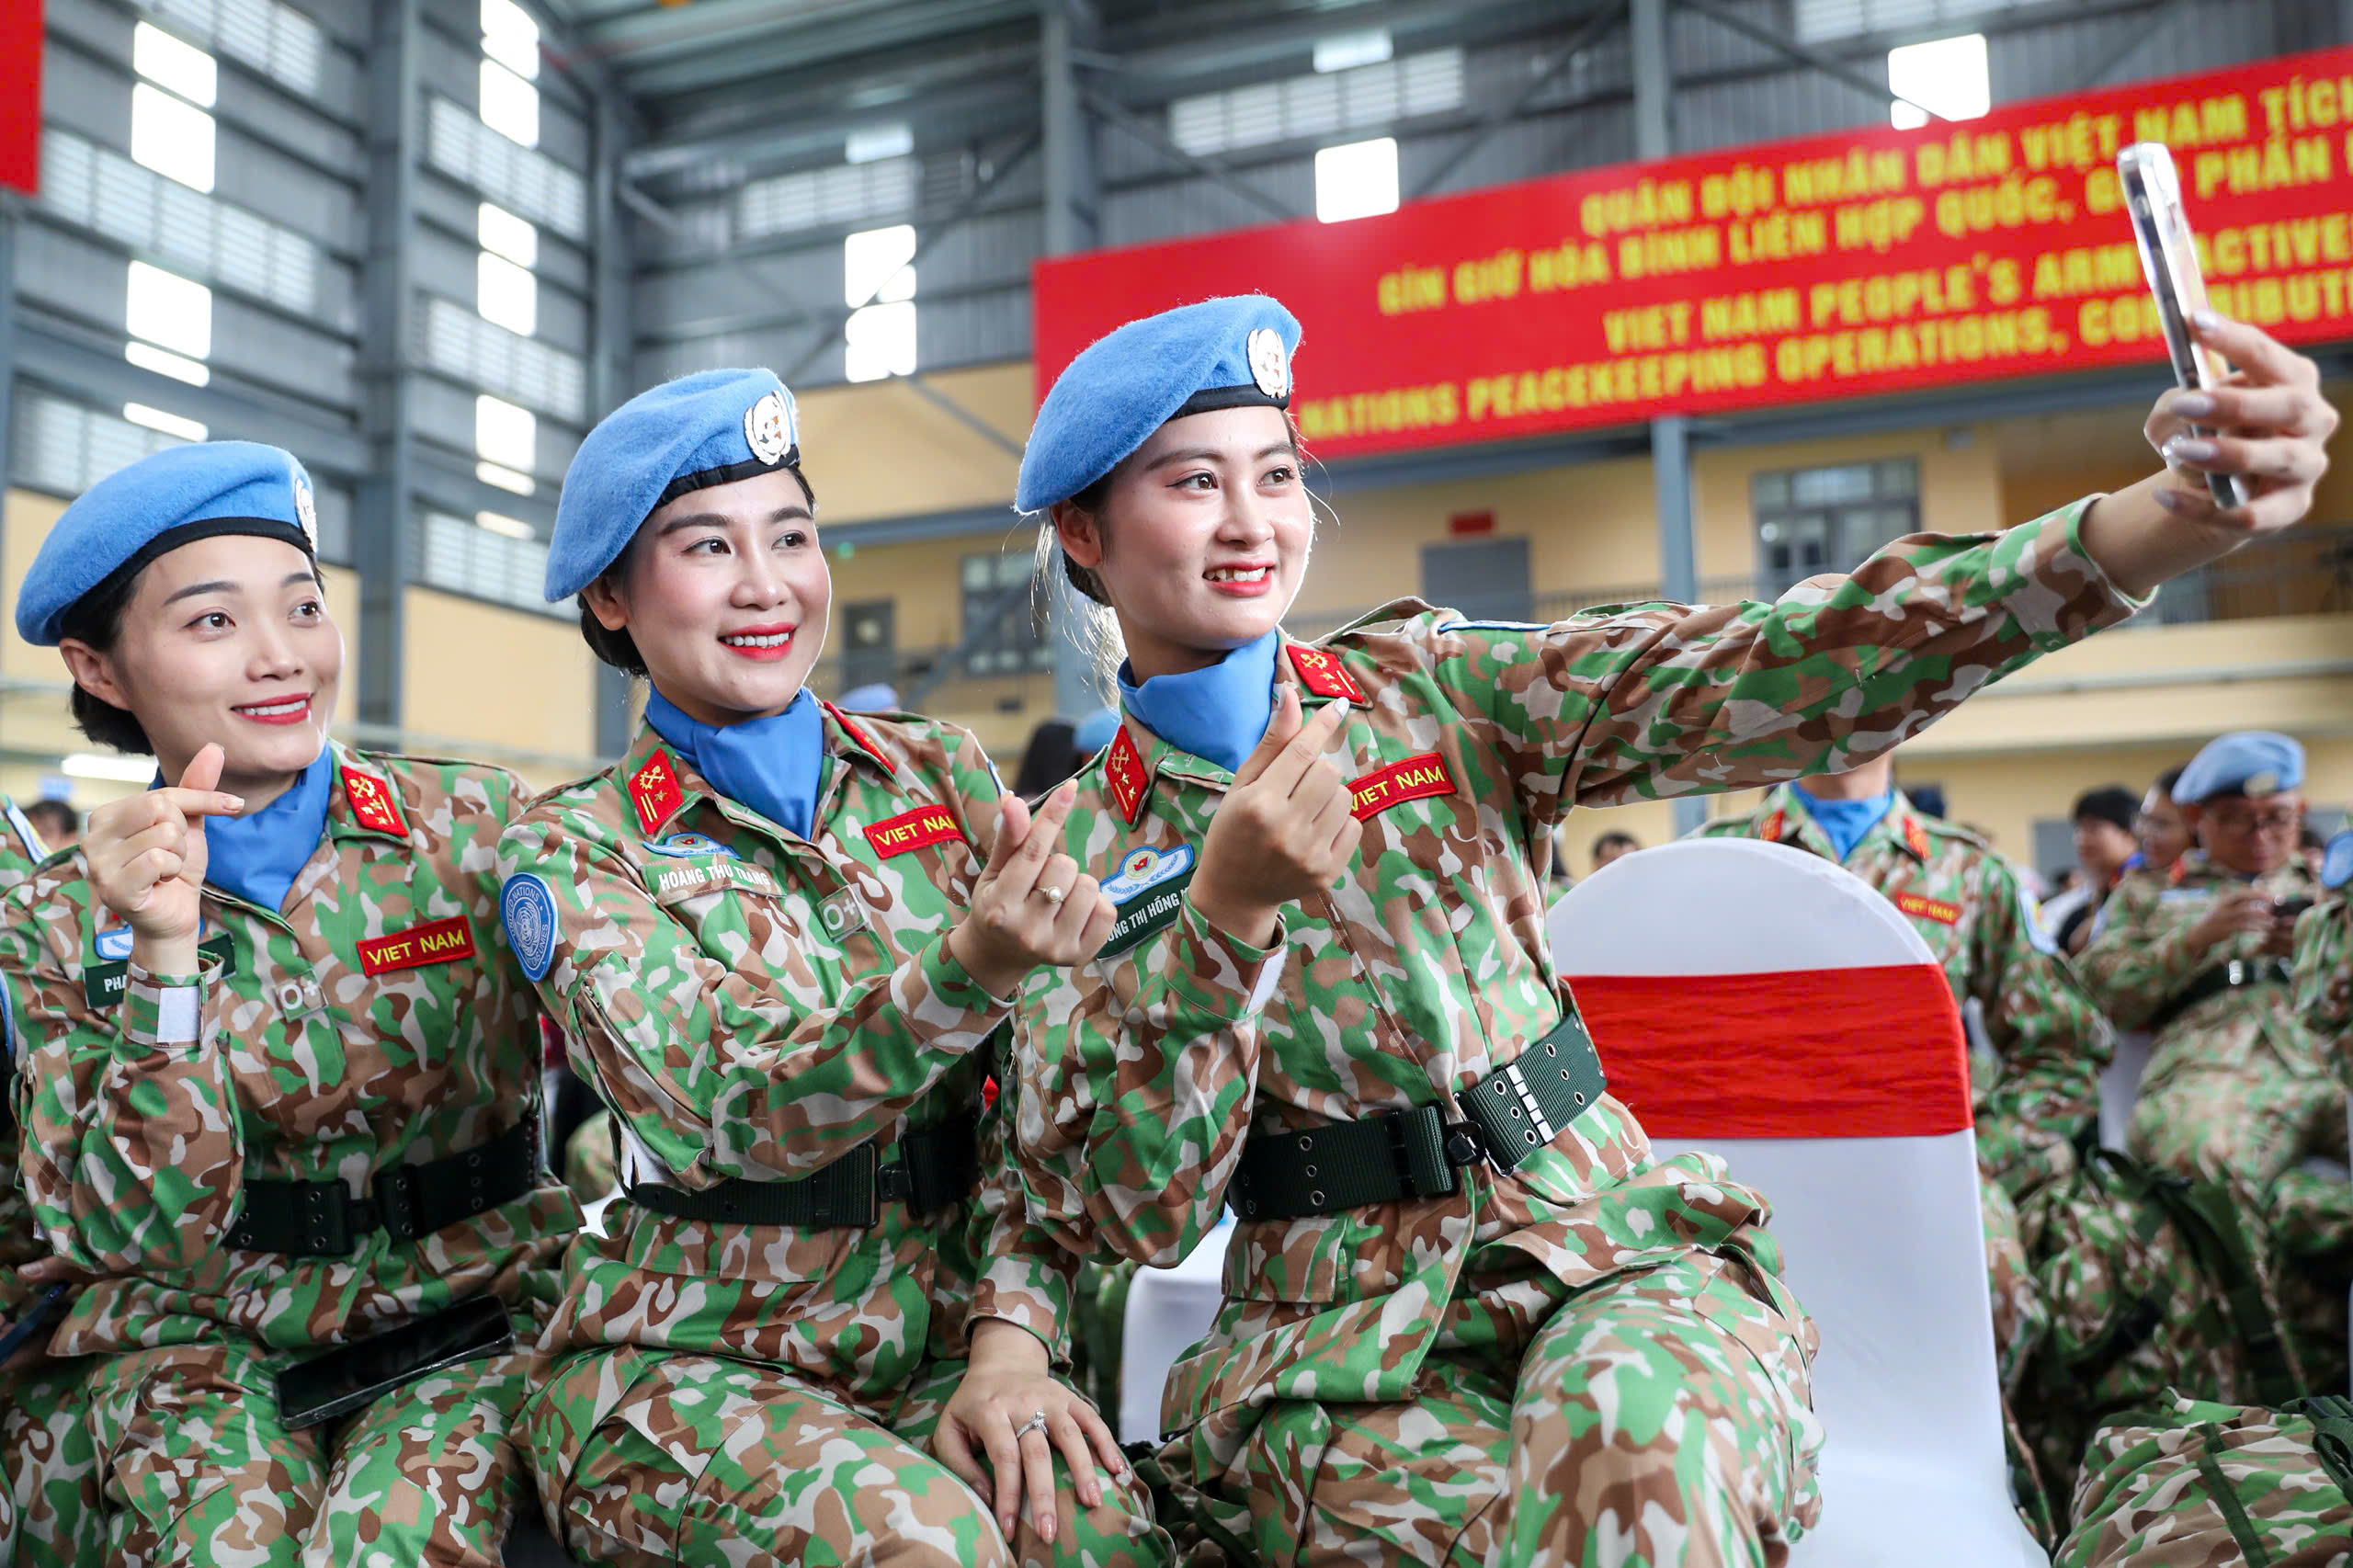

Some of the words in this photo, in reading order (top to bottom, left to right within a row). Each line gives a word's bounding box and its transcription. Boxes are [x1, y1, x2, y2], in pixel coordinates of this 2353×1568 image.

[2135, 96, 2246, 145] NAM
[1605, 304, 1689, 350] VIET
[1702, 290, 1799, 337] NAM
[2034, 243, 2141, 295] ARM
[1300, 384, 1457, 437] NATIONS
[1468, 344, 1766, 415] PEACEKEEPING
[1394, 766, 1446, 790] NAM
[875, 823, 917, 846] VIET
[511, 886, 540, 903] NATIONS
[658, 868, 706, 891] HOÀNG
[705, 864, 734, 882] THU
[1128, 907, 1149, 928] THỊ
[1146, 892, 1180, 918] HỒNG
[367, 941, 412, 966] VIET
[419, 928, 466, 954] NAM
